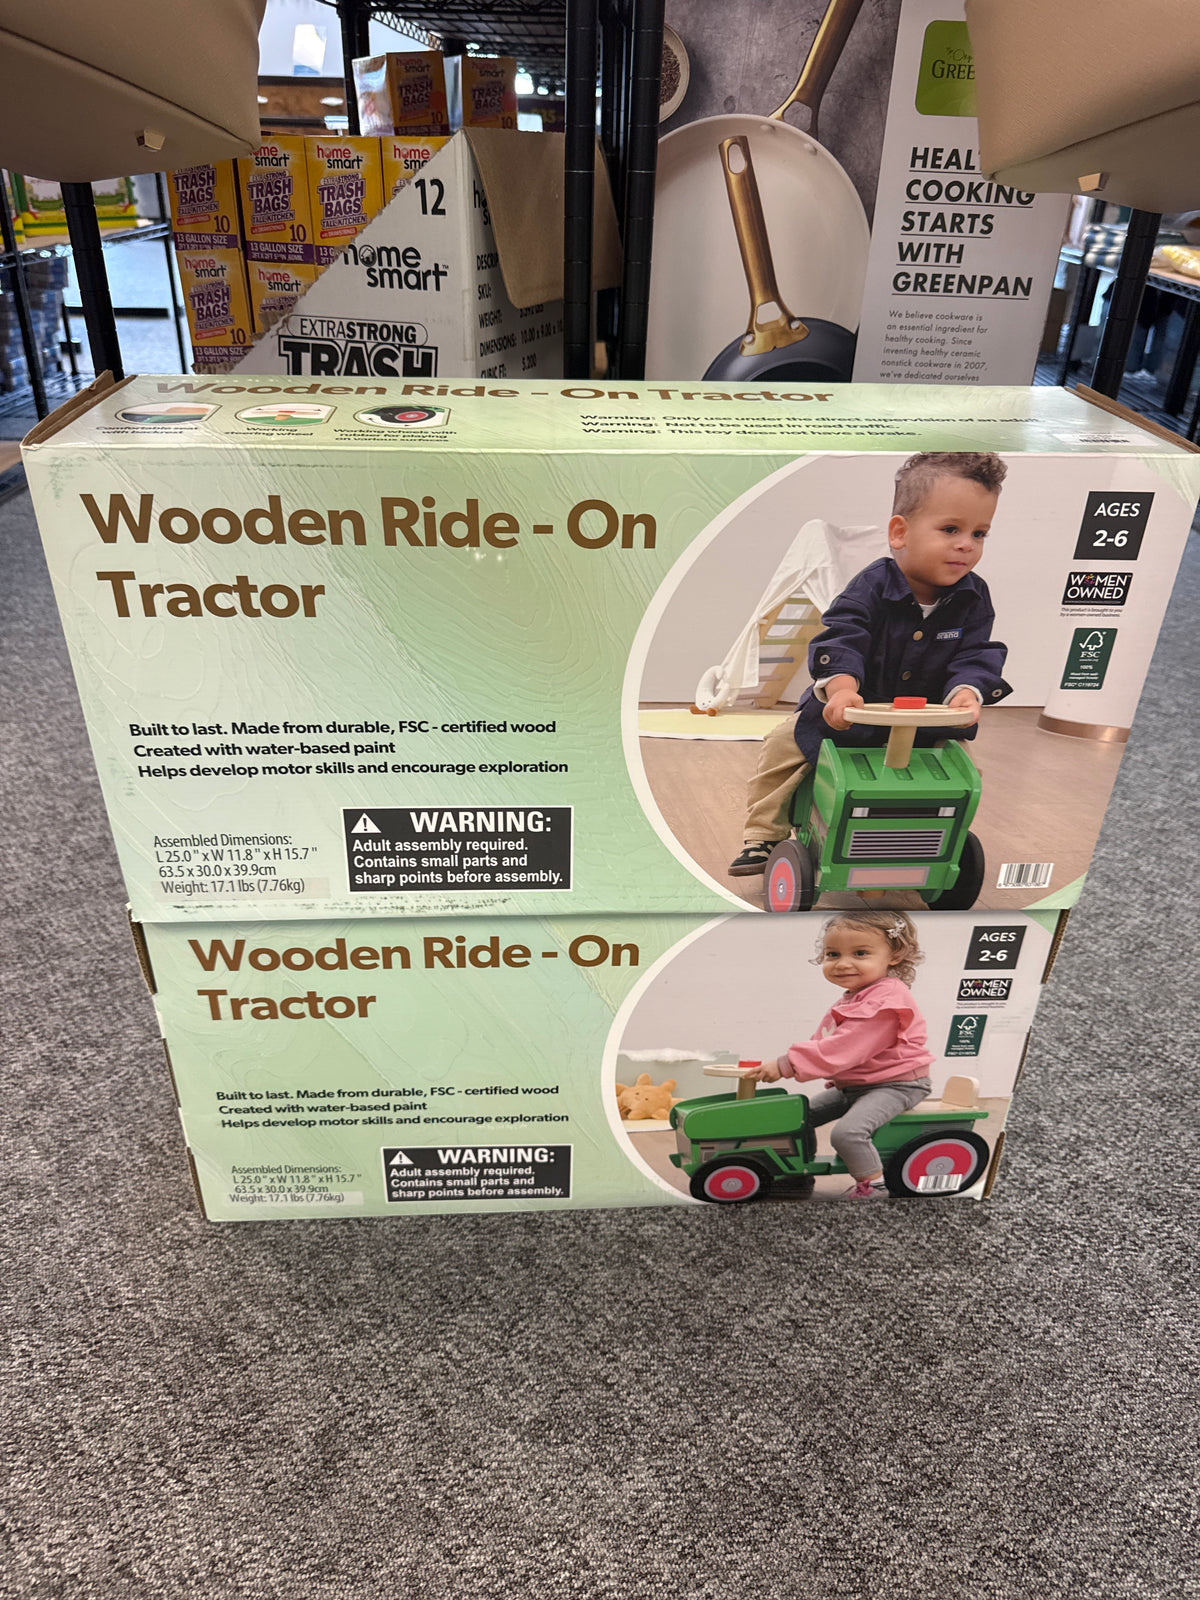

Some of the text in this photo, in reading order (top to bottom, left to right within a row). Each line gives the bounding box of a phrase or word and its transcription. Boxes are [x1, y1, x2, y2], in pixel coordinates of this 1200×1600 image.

[932, 60, 976, 80] GREE
[400, 80, 432, 97] TRASH
[431, 112, 443, 124] 10
[255, 154, 288, 166] smart
[317, 145, 351, 158] home
[910, 147, 977, 170] HEAL
[327, 156, 361, 169] smart
[174, 170, 216, 190] TRASH
[180, 187, 213, 205] BAGS
[248, 180, 291, 199] TRASH
[318, 180, 364, 202] TRASH
[414, 178, 446, 216] 12
[906, 179, 1036, 205] COOKING
[254, 196, 290, 213] BAGS
[324, 198, 362, 218] BAGS
[214, 215, 230, 233] 10
[901, 210, 994, 234] STARTS
[290, 224, 306, 242] 10
[250, 242, 304, 254] 13 GALLON SIZE
[343, 244, 422, 267] home
[898, 242, 964, 264] WITH
[366, 264, 447, 291] smart
[892, 272, 1033, 296] GREENPAN
[478, 285, 492, 300] SKU:
[479, 310, 502, 328] WEIGHT:
[889, 310, 983, 322] We believe cookware is
[300, 318, 416, 344] EXTRASTRONG
[899, 323, 933, 331] essential
[935, 325, 974, 334] ingredient
[977, 325, 988, 334] for
[480, 333, 517, 358] DIMENSIONS:
[520, 328, 535, 344] 10.00
[885, 334, 973, 346] healthy cooking. Since
[281, 339, 436, 377] TRASH
[883, 346, 981, 358] inventing healthy ceramic
[881, 359, 988, 371] nonstick cookware in 2007,
[880, 370, 980, 382] we've dedicated ourselves
[157, 383, 387, 395] Wooden
[401, 384, 520, 398] Ride
[560, 388, 639, 400] On
[648, 389, 834, 401] Tractor
[1094, 502, 1140, 517] AGES
[79, 493, 657, 550] Wooden Ride - On
[1093, 530, 1129, 547] 2-6
[96, 571, 326, 618] Tractor
[1067, 587, 1124, 599] OWNED
[129, 723, 170, 736] Built
[171, 724, 190, 736] to
[192, 722, 228, 735] last.
[232, 722, 280, 734] Made
[282, 722, 322, 734] from
[326, 721, 395, 735] durable,
[399, 720, 429, 733] FSC
[441, 720, 507, 733] certified
[511, 720, 556, 732] wood
[134, 742, 396, 757] Created with water-based paint
[138, 761, 568, 779] Helps develop motor skills and encourage exploration
[410, 811, 552, 833] WARNING:
[154, 833, 292, 848] Assembled Dimensions:
[353, 838, 528, 854] Adult assembly required.
[354, 854, 528, 869] Contains small parts and
[158, 864, 276, 878] 63.5 x 30.0 x 39.9cm
[355, 870, 563, 886] sharp points before assembly.
[161, 878, 305, 896] Weight: 17.1 lbs (7.76kg)
[978, 932, 1017, 942] AGES
[187, 938, 411, 972] Wooden
[424, 935, 532, 968] Ride
[568, 934, 639, 967] On
[978, 949, 1008, 962] 2-6
[960, 987, 1007, 997] OWNED
[197, 989, 376, 1020] Tractor
[216, 1091, 247, 1101] Built
[248, 1091, 264, 1100] to
[265, 1091, 294, 1100] last.
[296, 1089, 335, 1099] Made
[336, 1089, 369, 1098] from
[371, 1087, 428, 1098] durable,
[430, 1086, 455, 1096] FSC
[464, 1086, 519, 1096] certified
[521, 1085, 560, 1095] wood
[437, 1148, 555, 1164] WARNING:
